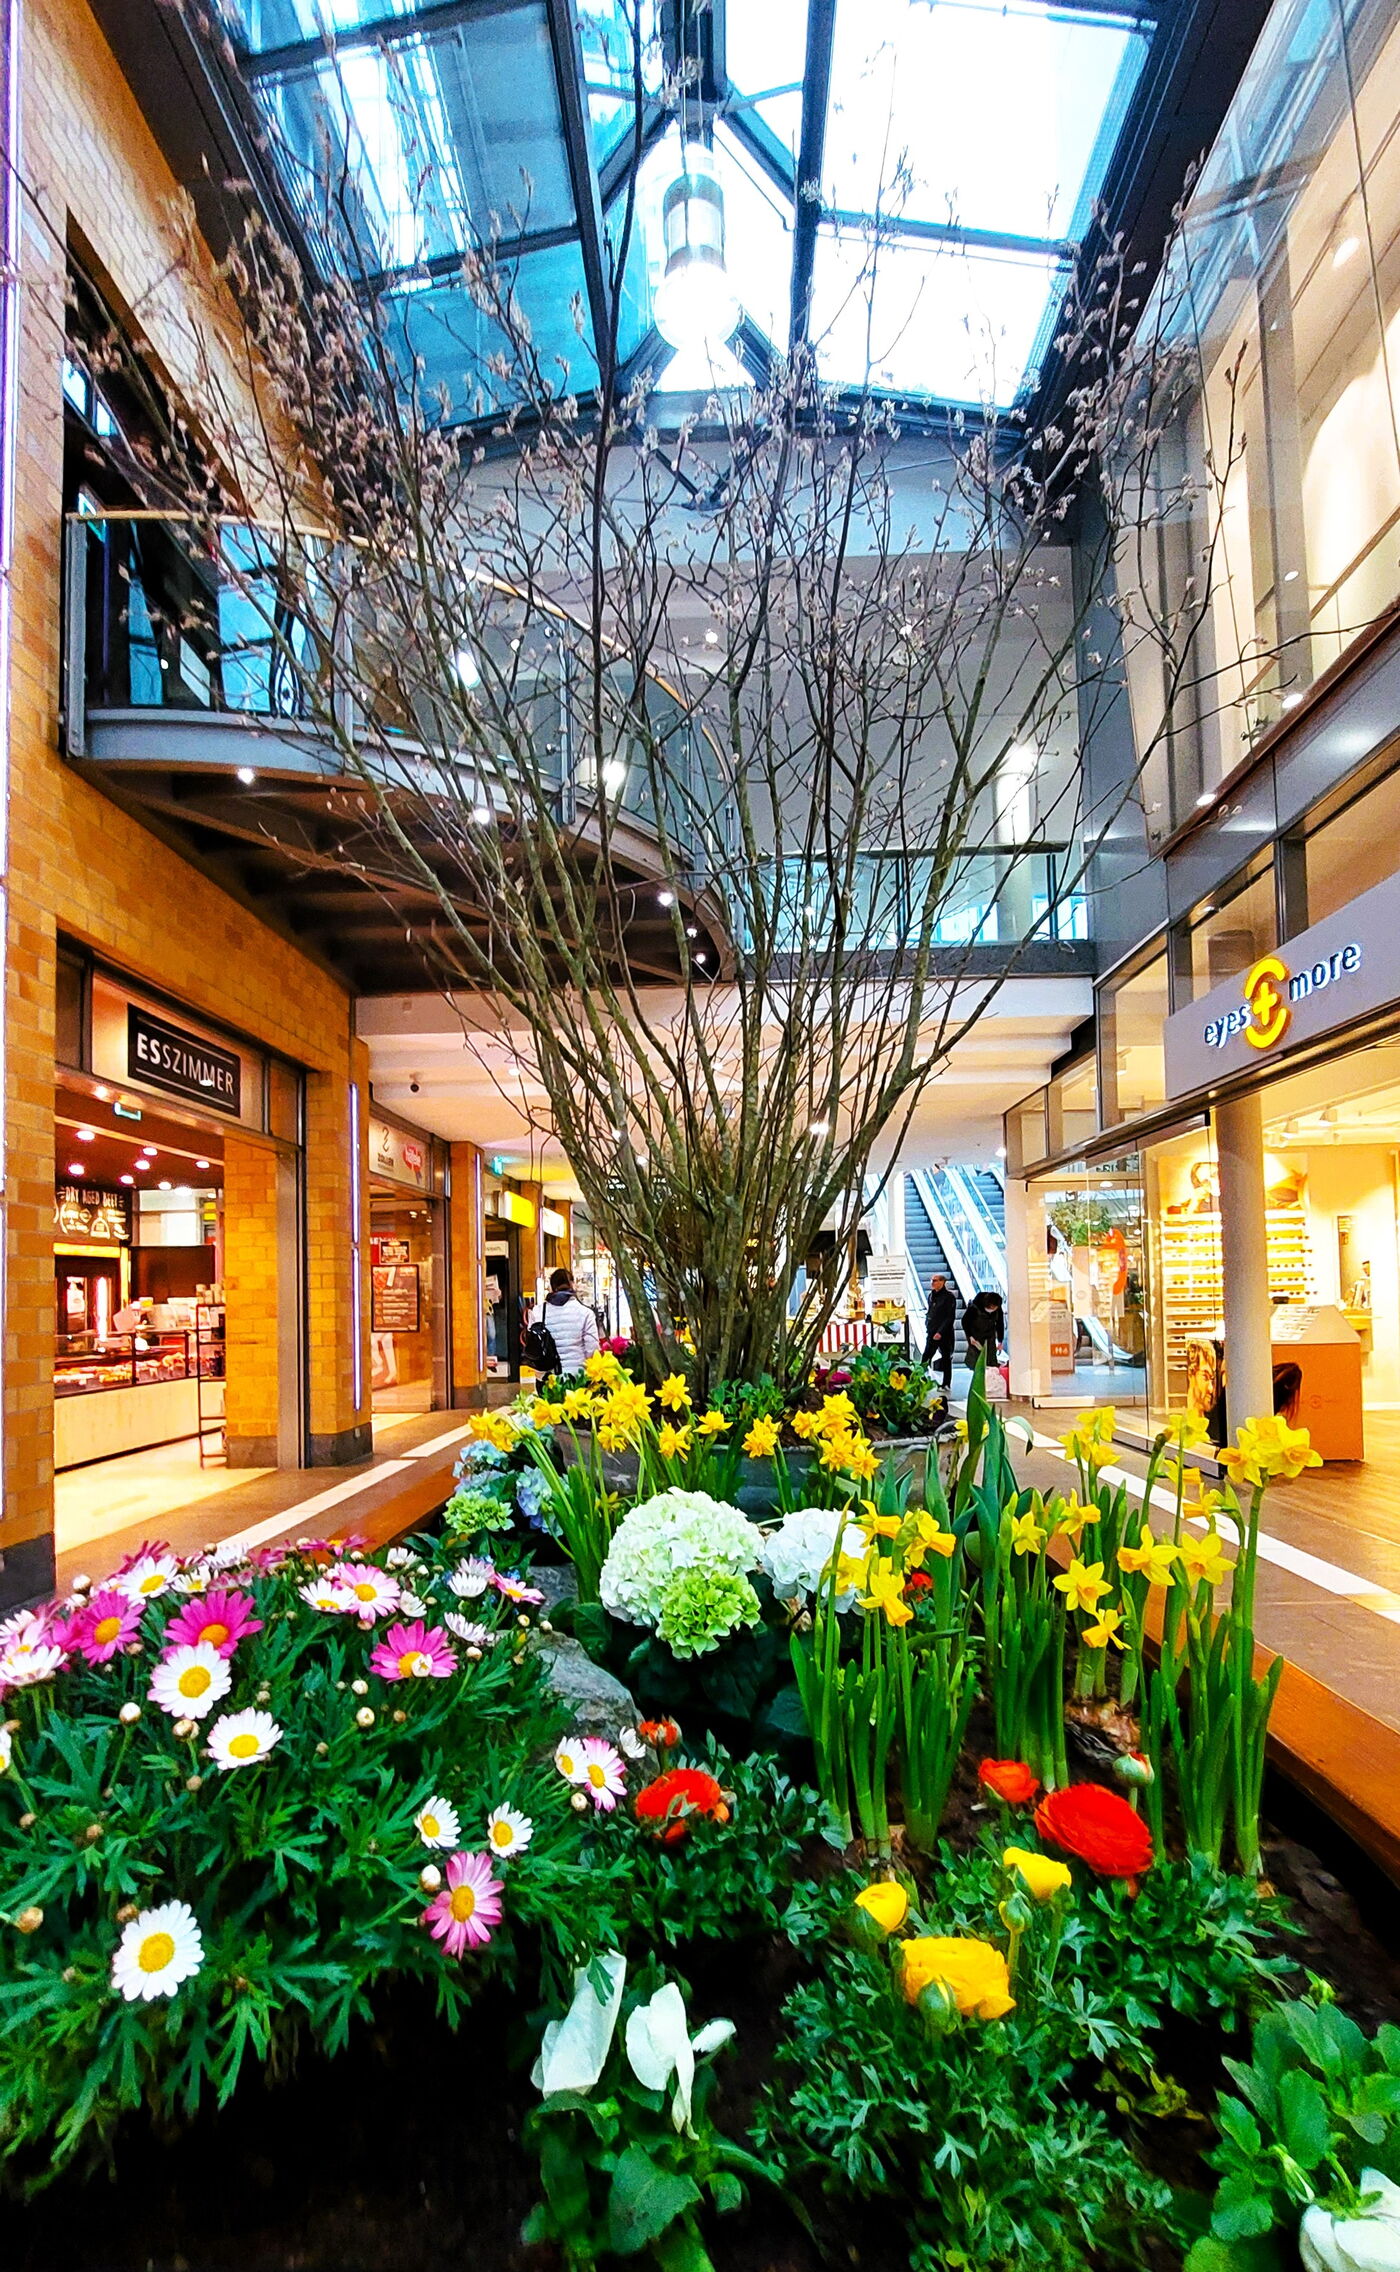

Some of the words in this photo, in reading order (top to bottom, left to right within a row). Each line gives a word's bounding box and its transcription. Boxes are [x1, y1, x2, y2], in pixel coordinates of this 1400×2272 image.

[1204, 1003, 1252, 1048] eyes
[1288, 943, 1361, 1002] more
[137, 1032, 234, 1096] ESSZIMMER
